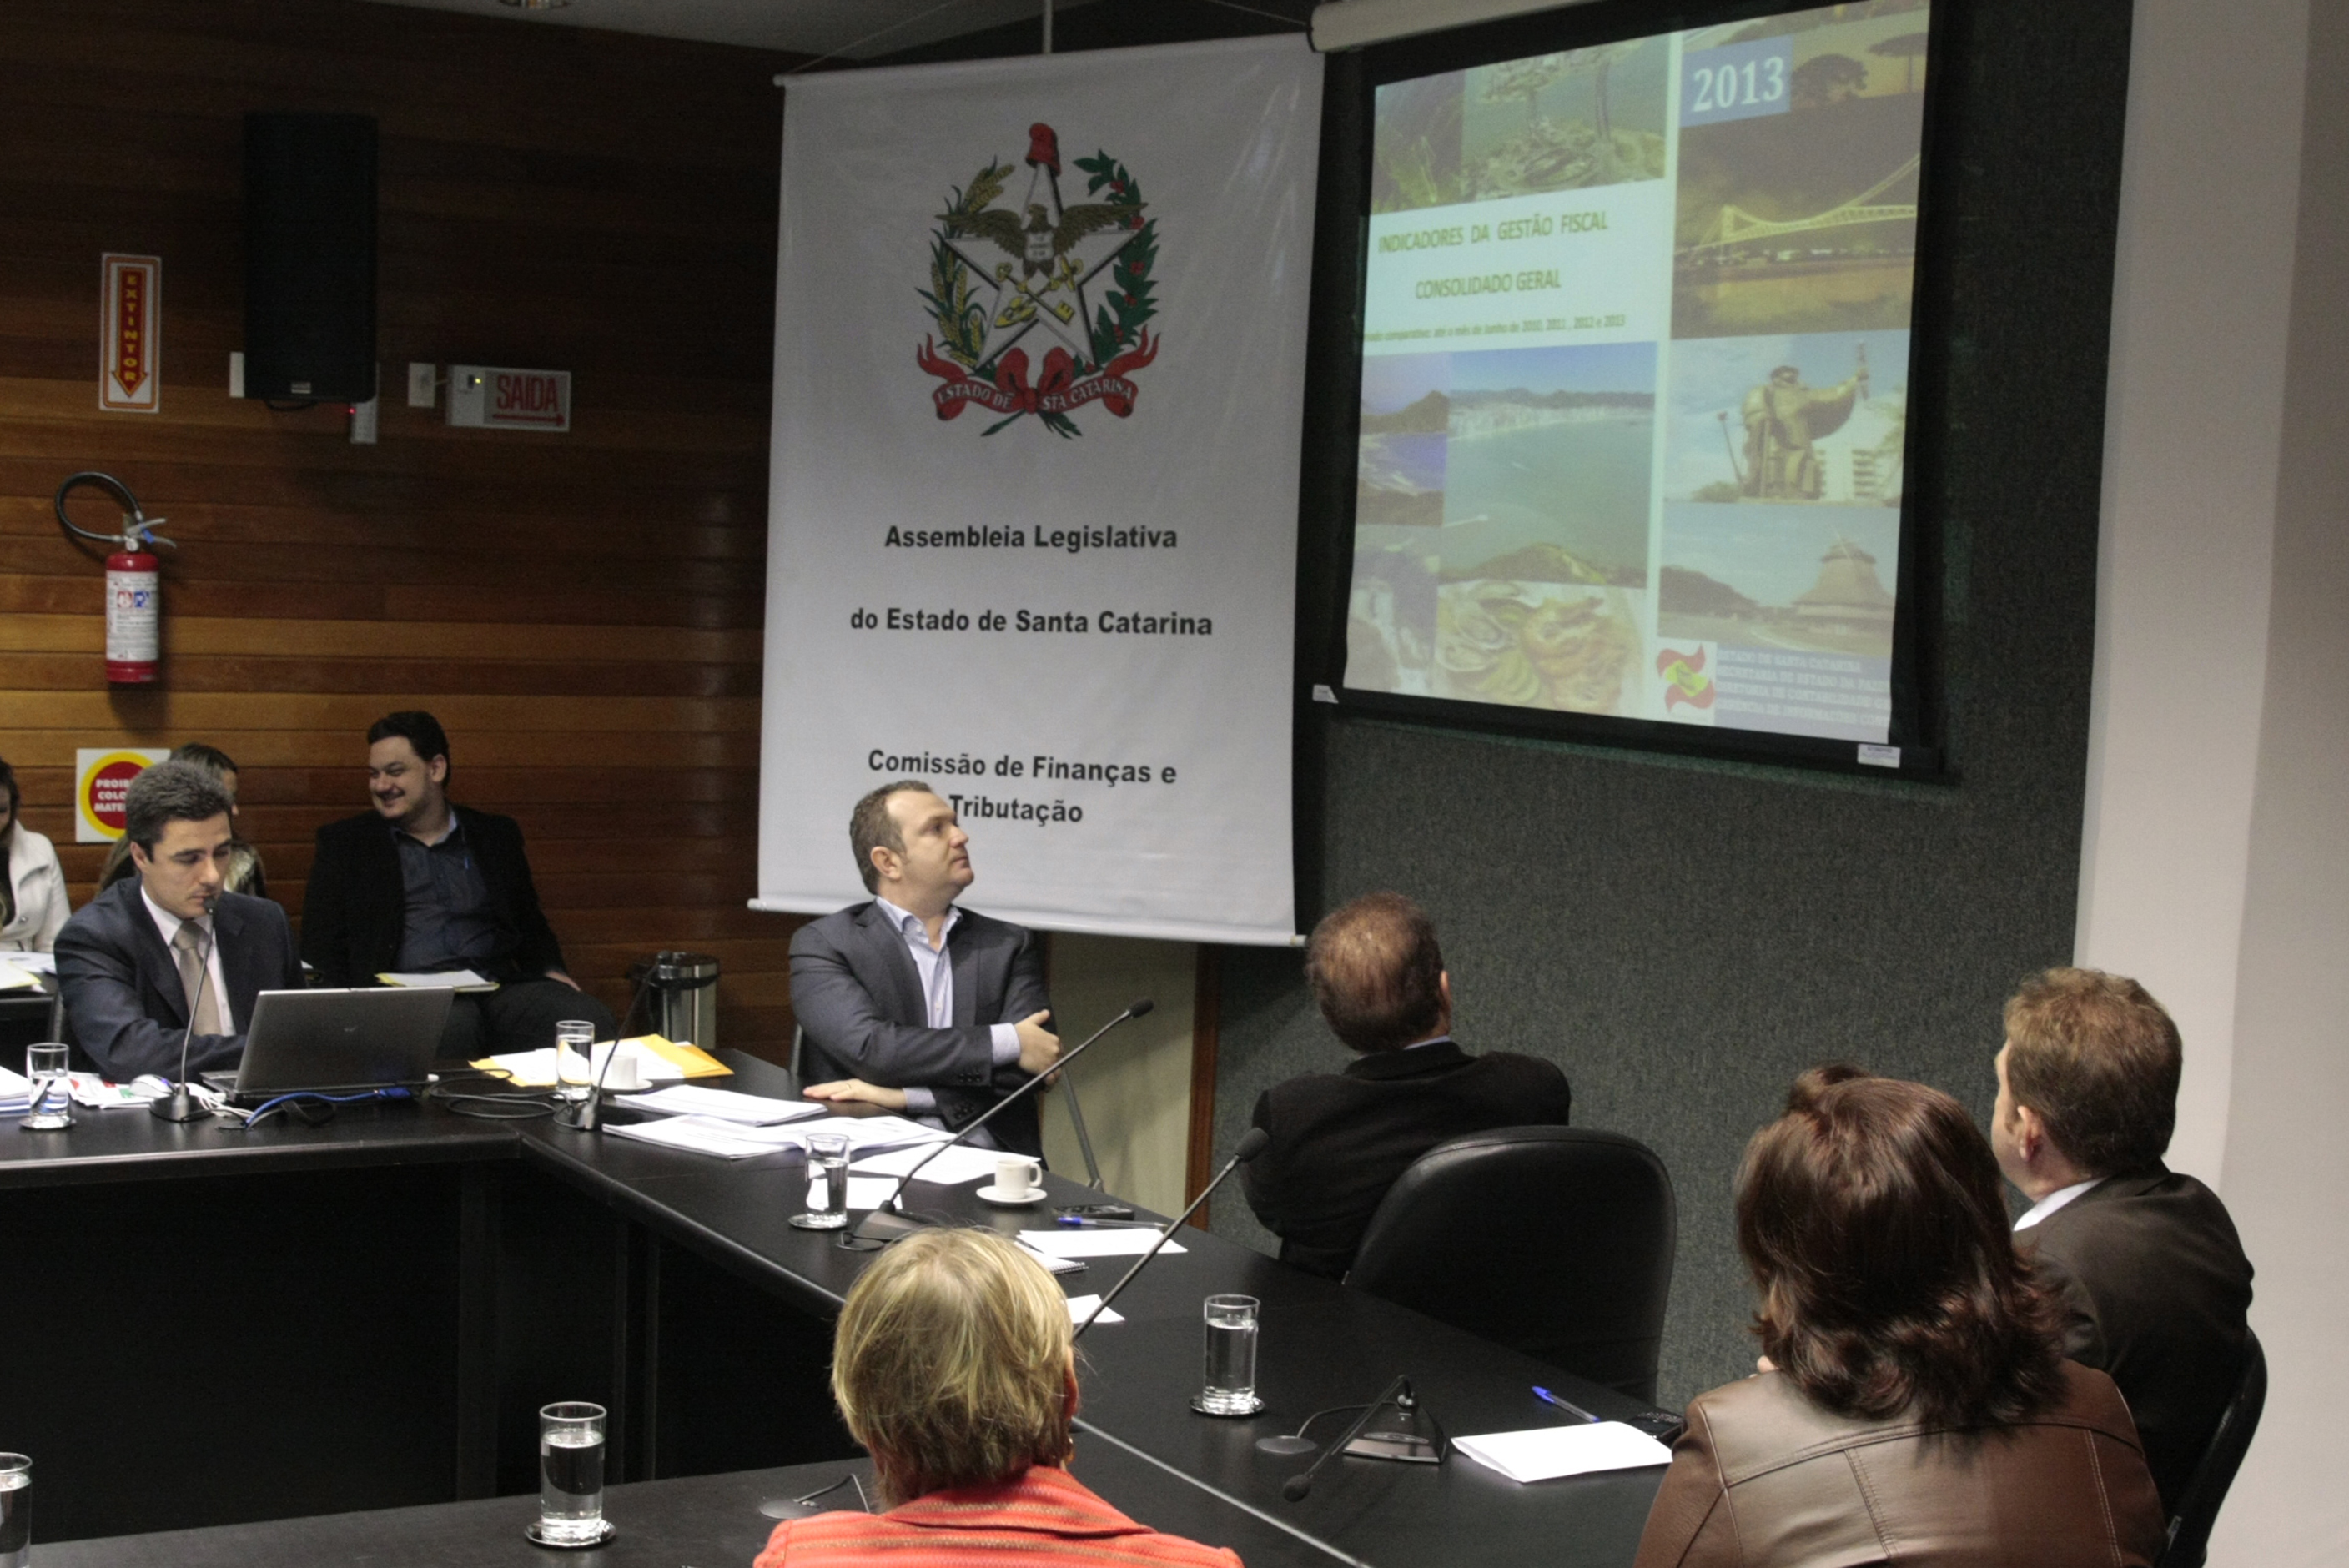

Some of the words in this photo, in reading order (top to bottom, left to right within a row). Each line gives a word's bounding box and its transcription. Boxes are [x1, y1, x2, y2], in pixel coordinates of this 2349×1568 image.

[1692, 55, 1783, 112] 2013
[1378, 227, 1464, 254] INDICADORES
[1471, 224, 1490, 244] DA
[1497, 213, 1553, 241] GESTÃO
[1561, 211, 1608, 234] FISCAL
[1416, 273, 1512, 299] CONSOLIDADO
[1517, 269, 1562, 293] GERAL
[124, 274, 138, 381] EXTINTOR
[938, 384, 990, 405] ESTADO
[1069, 379, 1133, 403] CATARINA
[884, 525, 1026, 549] Assembleia
[1034, 525, 1178, 555] Legislativa
[851, 608, 878, 630] do
[887, 607, 970, 631] Estado
[978, 609, 1007, 632] de
[1015, 609, 1089, 633] Santa
[1098, 611, 1213, 636] Catarina
[868, 749, 986, 776] Comissão
[994, 755, 1024, 778] de
[1033, 756, 1151, 787] Finanças
[1161, 766, 1177, 784] e
[949, 794, 1084, 827] Tributação
